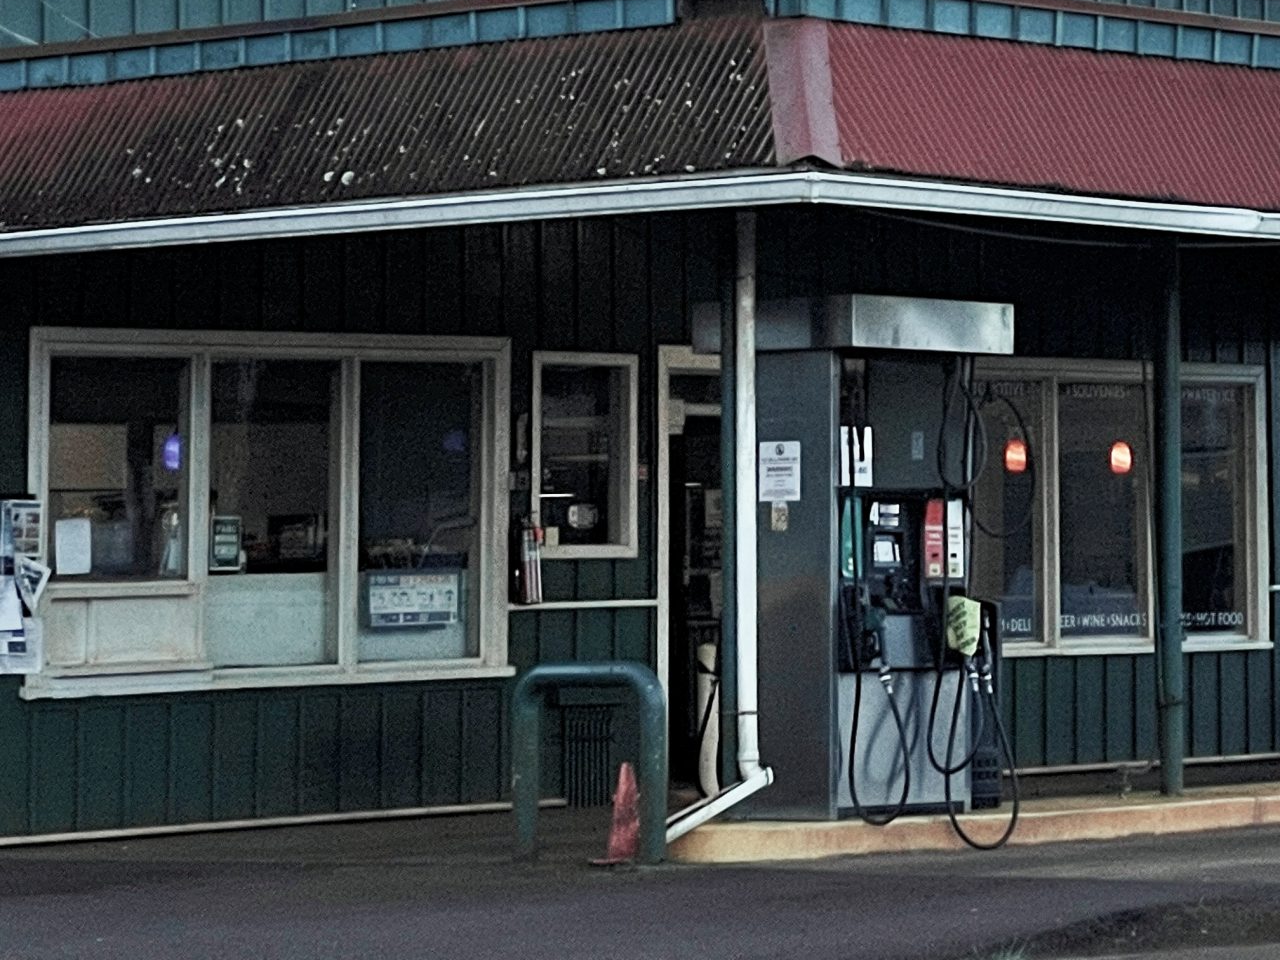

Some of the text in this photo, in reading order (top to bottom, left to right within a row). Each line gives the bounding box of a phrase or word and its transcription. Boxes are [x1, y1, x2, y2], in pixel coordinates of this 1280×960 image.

[1010, 617, 1032, 632] DELI
[1060, 612, 1147, 628] EER WINE SNACKS
[1218, 612, 1244, 626] FOOD
